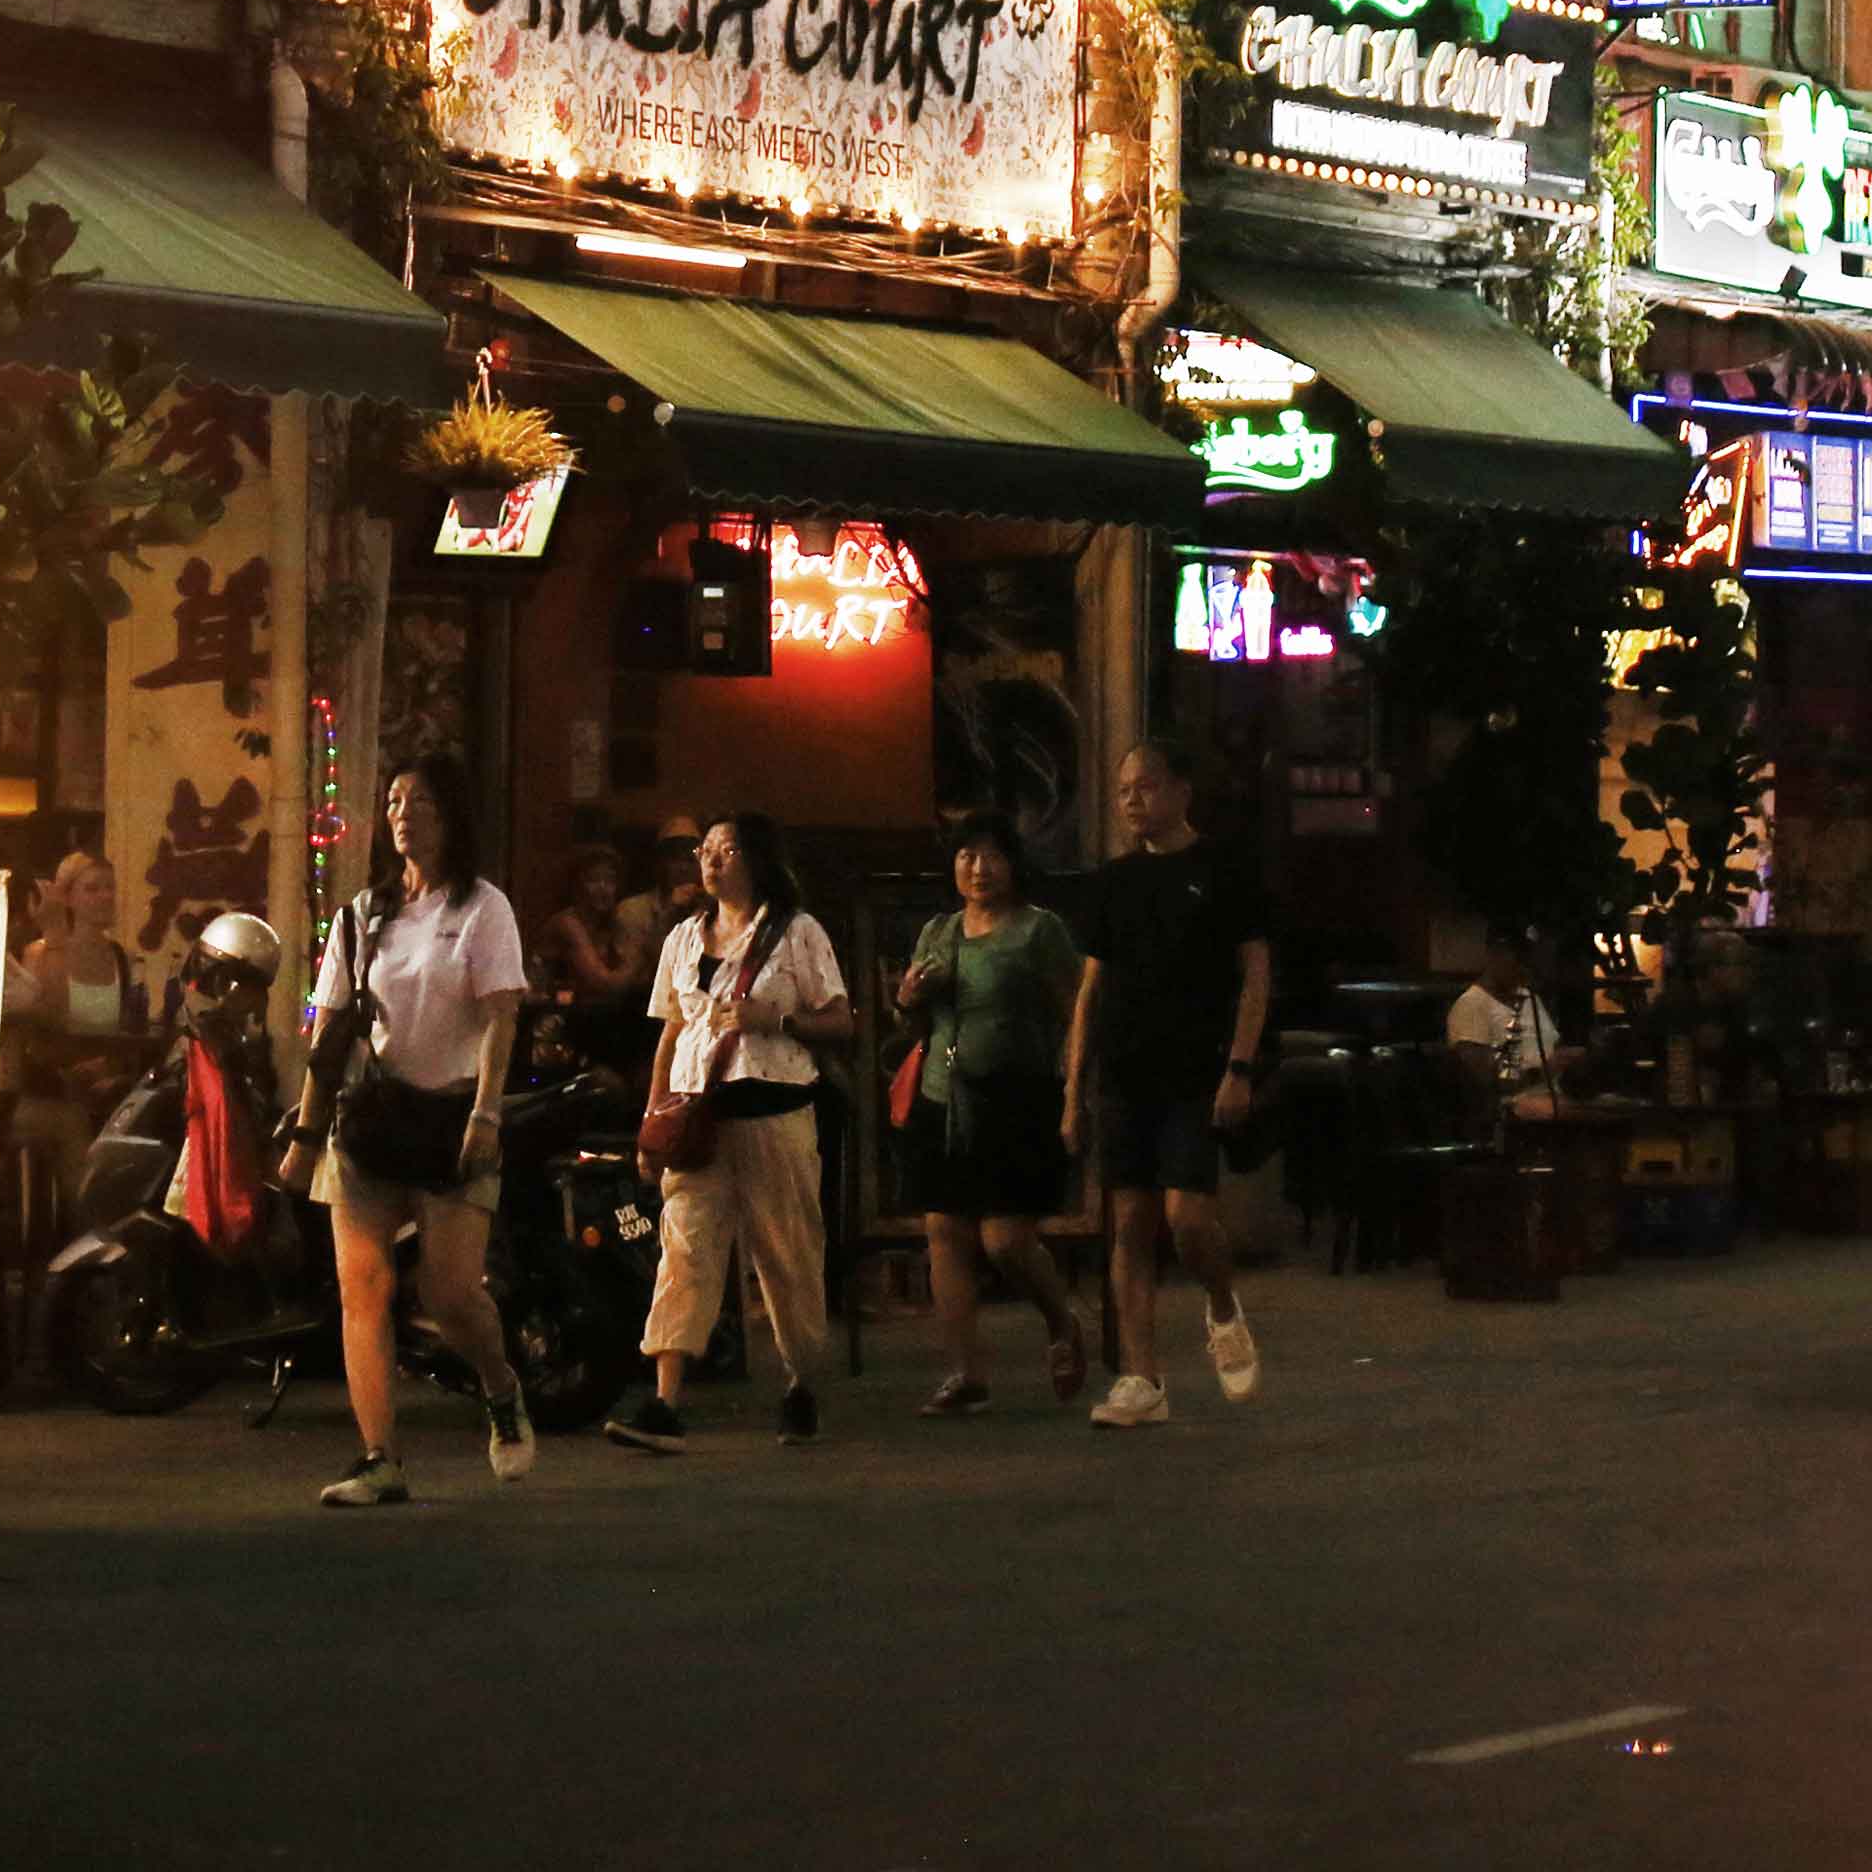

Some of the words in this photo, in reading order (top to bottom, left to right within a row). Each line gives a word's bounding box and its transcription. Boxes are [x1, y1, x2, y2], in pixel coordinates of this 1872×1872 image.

[1242, 6, 1428, 107] CHULIA
[1424, 41, 1564, 138] COURT
[596, 95, 684, 146] WHERE
[690, 107, 749, 153] EAST
[758, 118, 836, 167] MEETS
[842, 136, 906, 179] WEST
[771, 595, 908, 651] OURT
